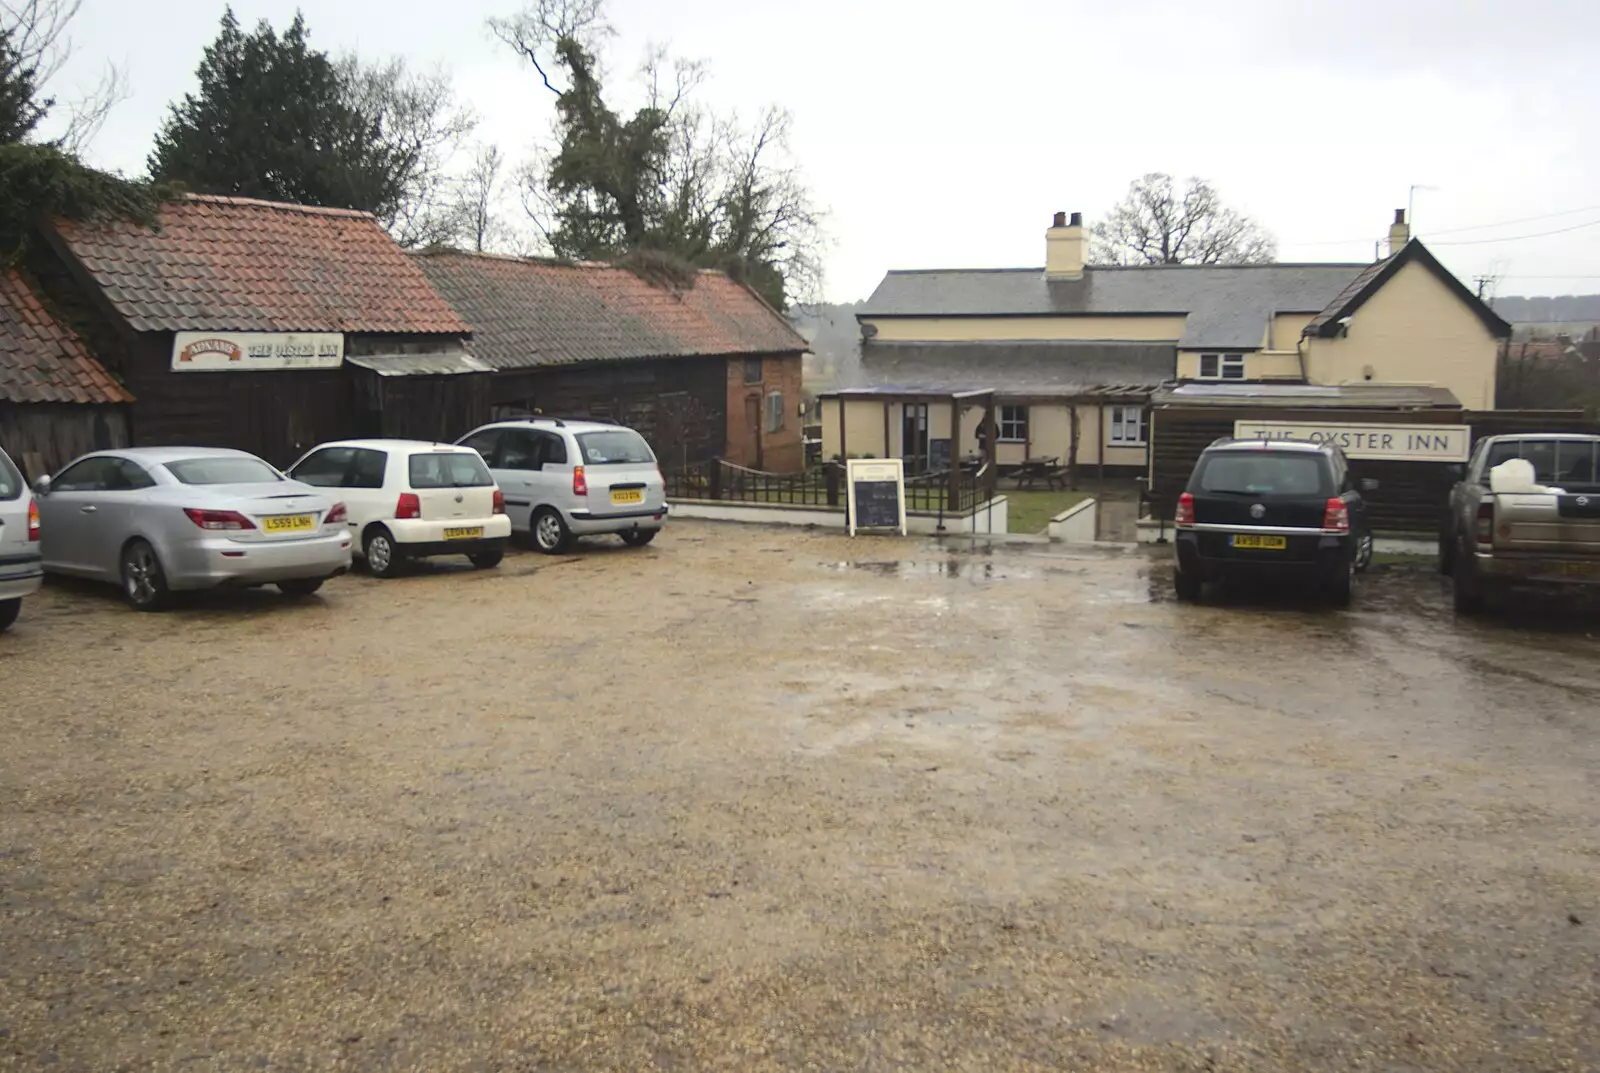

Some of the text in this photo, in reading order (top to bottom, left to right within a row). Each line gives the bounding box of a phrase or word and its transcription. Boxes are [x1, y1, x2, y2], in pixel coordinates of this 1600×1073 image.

[248, 344, 272, 358] THE
[1309, 431, 1394, 450] OYSTER
[1408, 434, 1449, 451] INN
[266, 518, 292, 529] LS59
